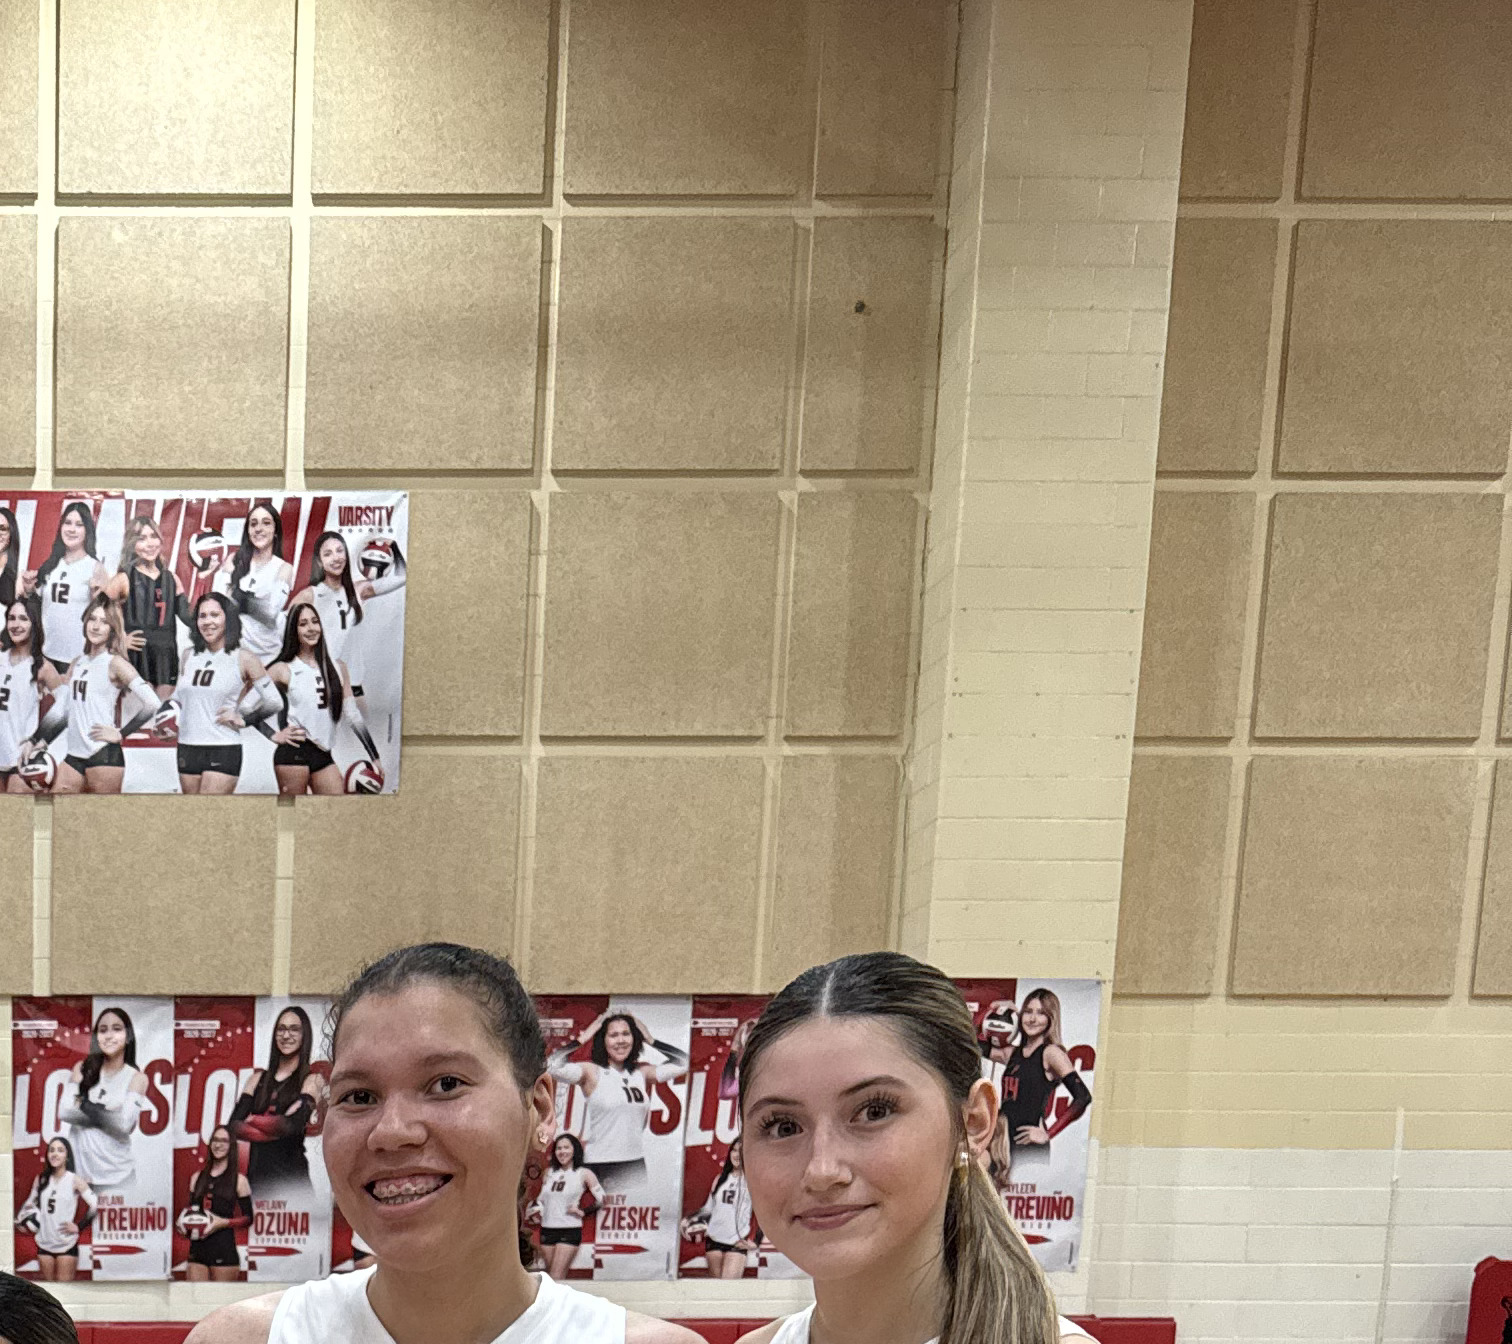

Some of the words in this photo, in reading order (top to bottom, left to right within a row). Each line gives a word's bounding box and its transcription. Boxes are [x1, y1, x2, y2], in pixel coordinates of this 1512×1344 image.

[338, 505, 394, 527] VARSITY
[50, 582, 70, 604] 12
[154, 601, 167, 627] 7
[191, 669, 215, 687] 10
[73, 680, 87, 702] 14
[623, 1086, 644, 1103] 10
[551, 1181, 565, 1192] 10
[722, 1190, 736, 1204] 12
[47, 1199, 56, 1214] 5
[97, 1202, 167, 1231] TREVIÑO
[1005, 1190, 1075, 1221] TREVIÑO
[254, 1212, 309, 1236] OZUNA
[600, 1206, 660, 1231] ZIESKE
